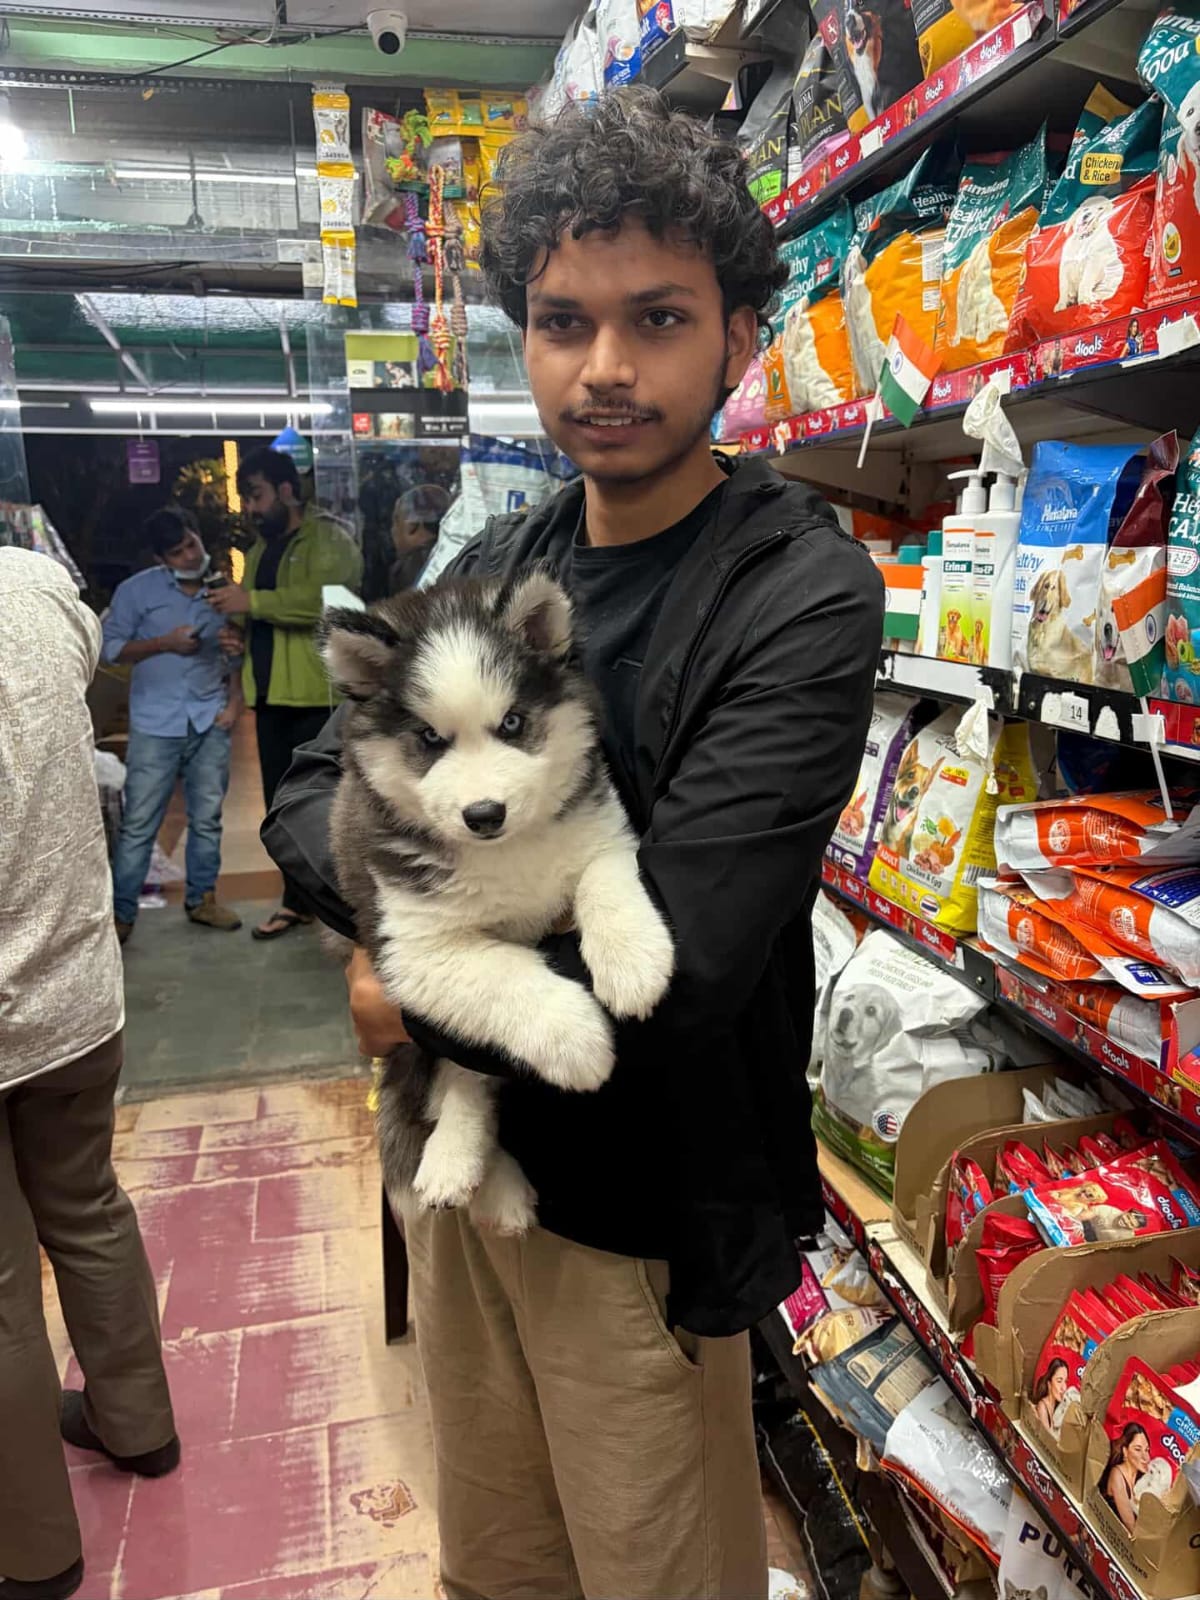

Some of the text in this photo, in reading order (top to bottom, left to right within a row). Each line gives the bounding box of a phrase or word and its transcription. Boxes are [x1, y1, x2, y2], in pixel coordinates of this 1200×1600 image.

[980, 35, 1003, 60] drools
[924, 79, 944, 100] drools
[1085, 157, 1121, 171] Chicken
[1083, 170, 1111, 182] & Rice
[1075, 335, 1104, 358] drools
[944, 562, 967, 572] Erina
[1070, 704, 1083, 721] 14
[880, 848, 898, 867] ADULT
[906, 863, 926, 881] Chicken
[930, 876, 942, 889] Egg
[1102, 1042, 1130, 1070] drools
[1157, 1196, 1182, 1229] drools
